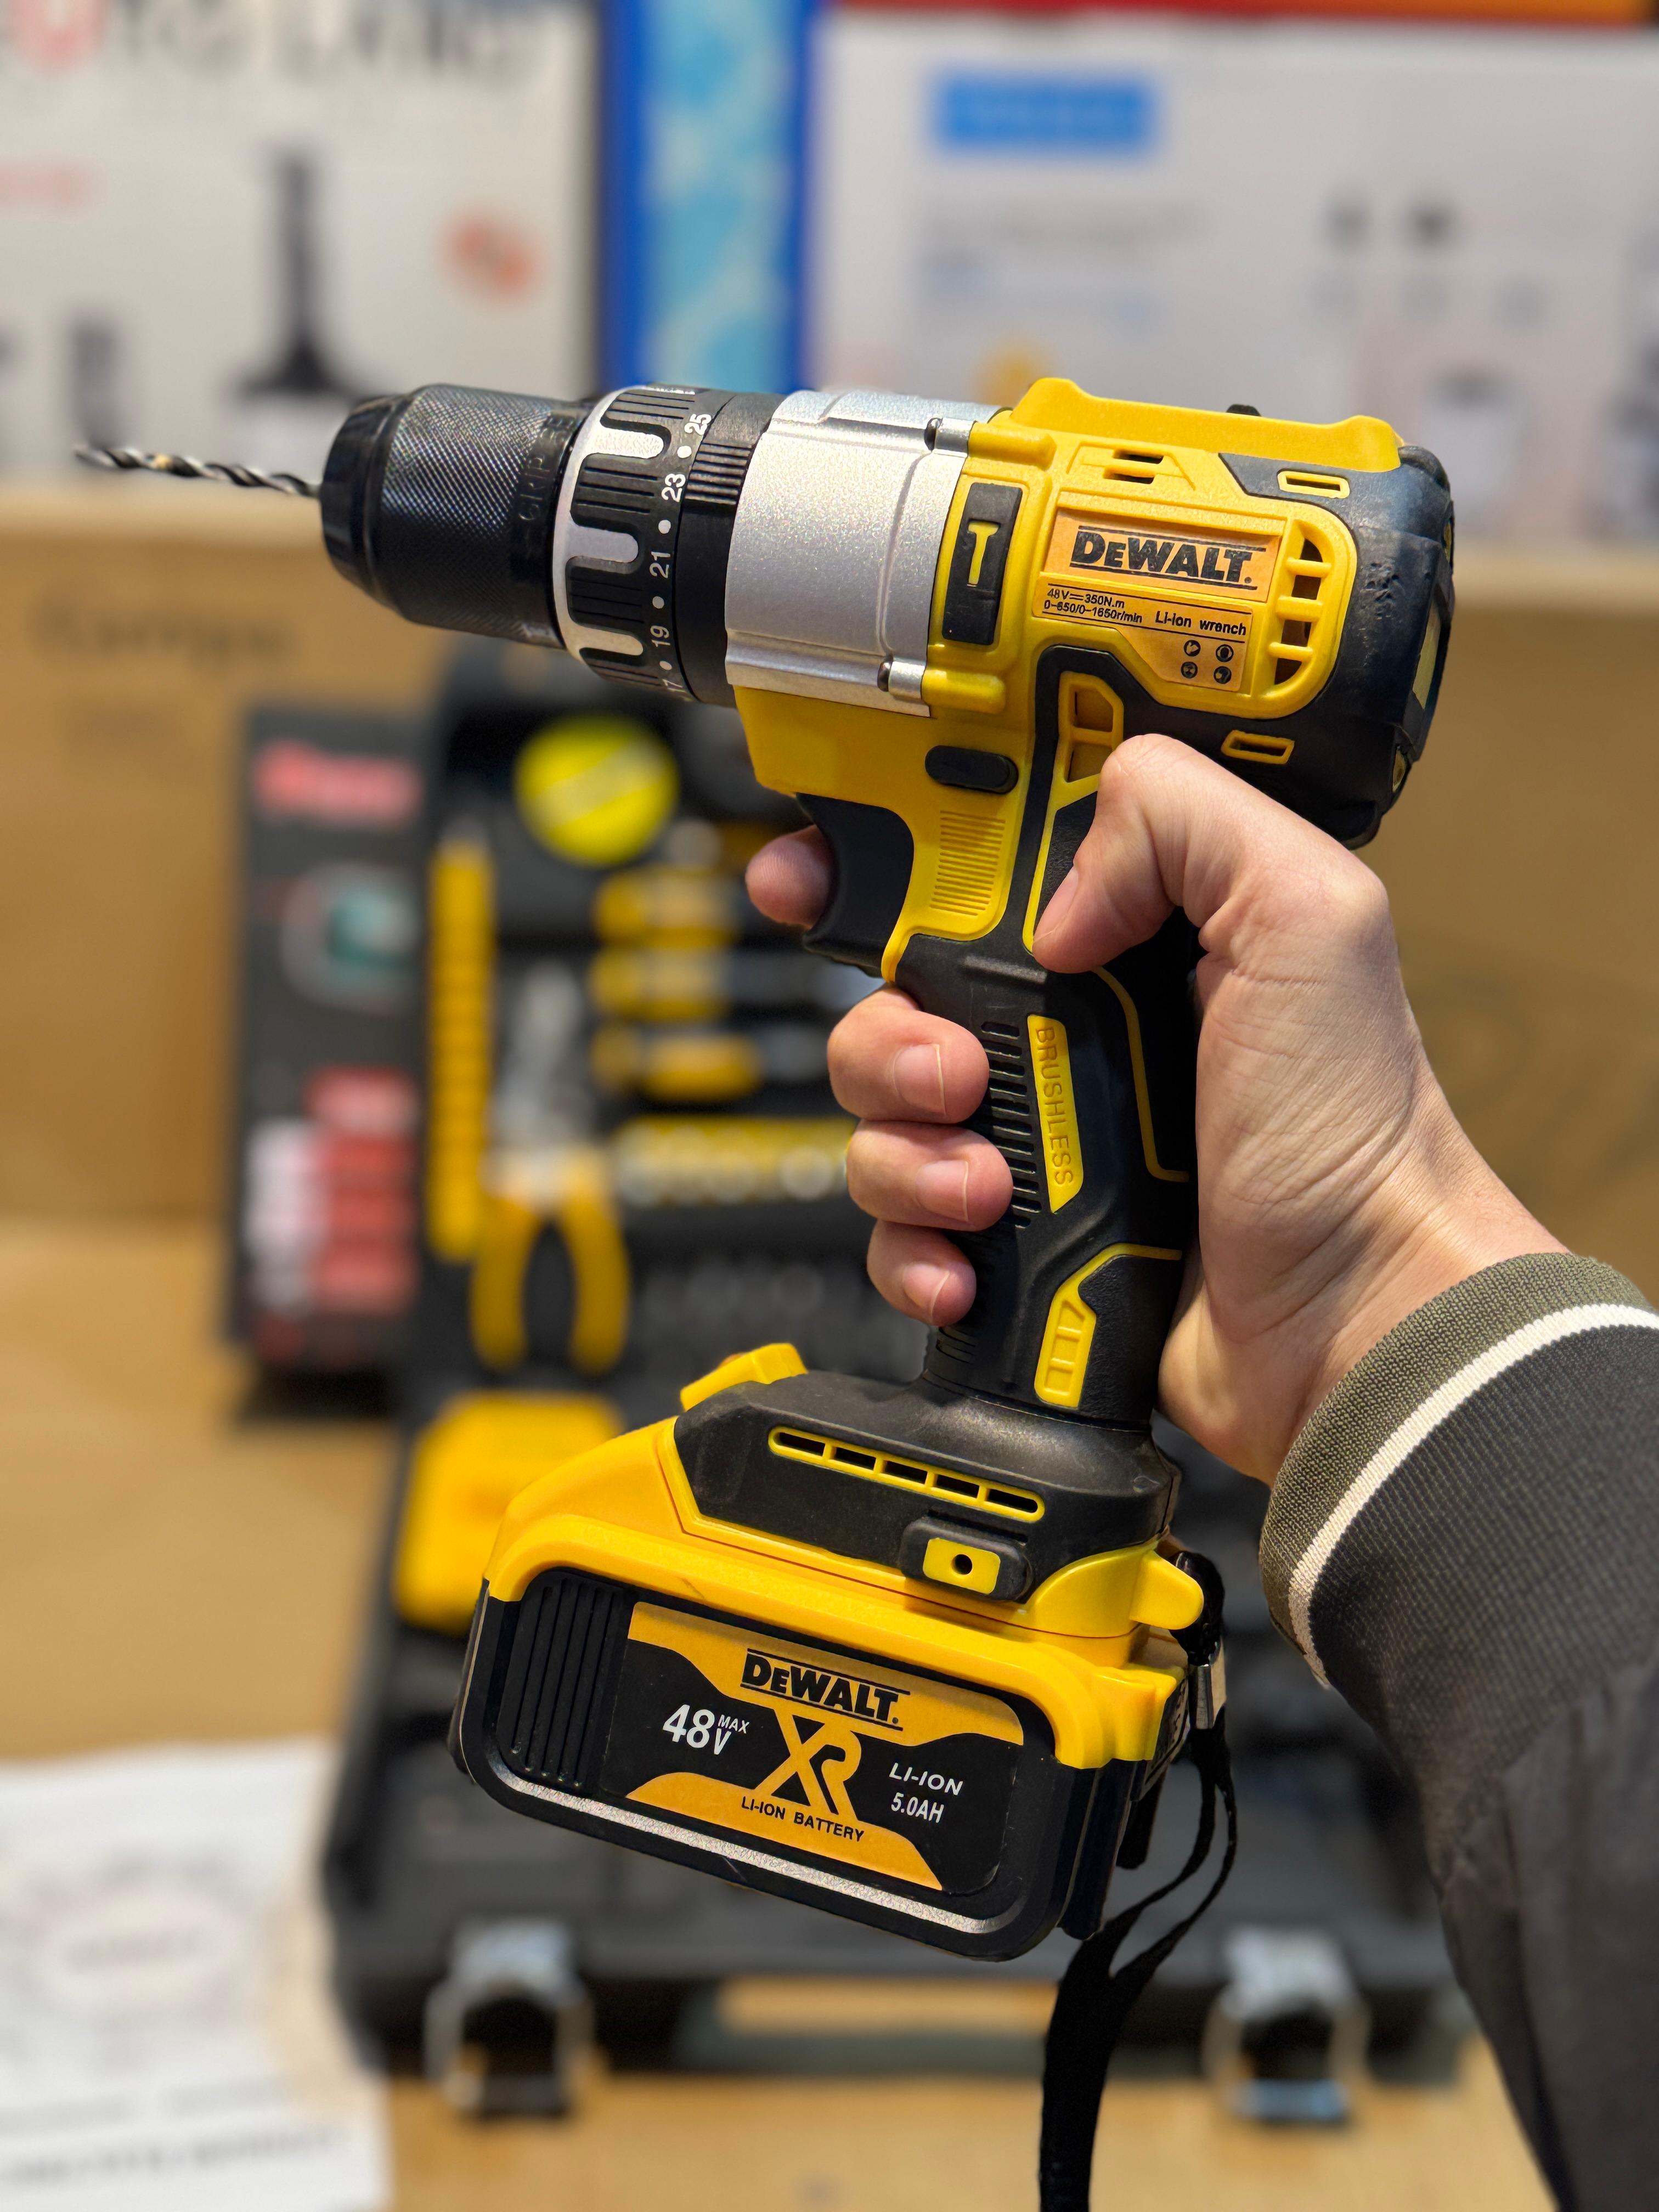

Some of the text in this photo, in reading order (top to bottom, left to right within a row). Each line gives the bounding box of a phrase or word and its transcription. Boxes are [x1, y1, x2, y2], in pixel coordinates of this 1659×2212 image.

[684, 414, 712, 435] 25
[662, 473, 686, 503] 23
[650, 551, 671, 578] 21
[650, 625, 670, 647] 19
[1199, 619, 1246, 636] wrench
[1036, 1026, 1073, 1185] BRUSHLESS
[718, 1714, 749, 1734] MAX
[889, 1762, 963, 1796] LI-ION
[742, 1796, 865, 1842] LI-ION BATTERY
[891, 1792, 944, 1823] 5.0AH
